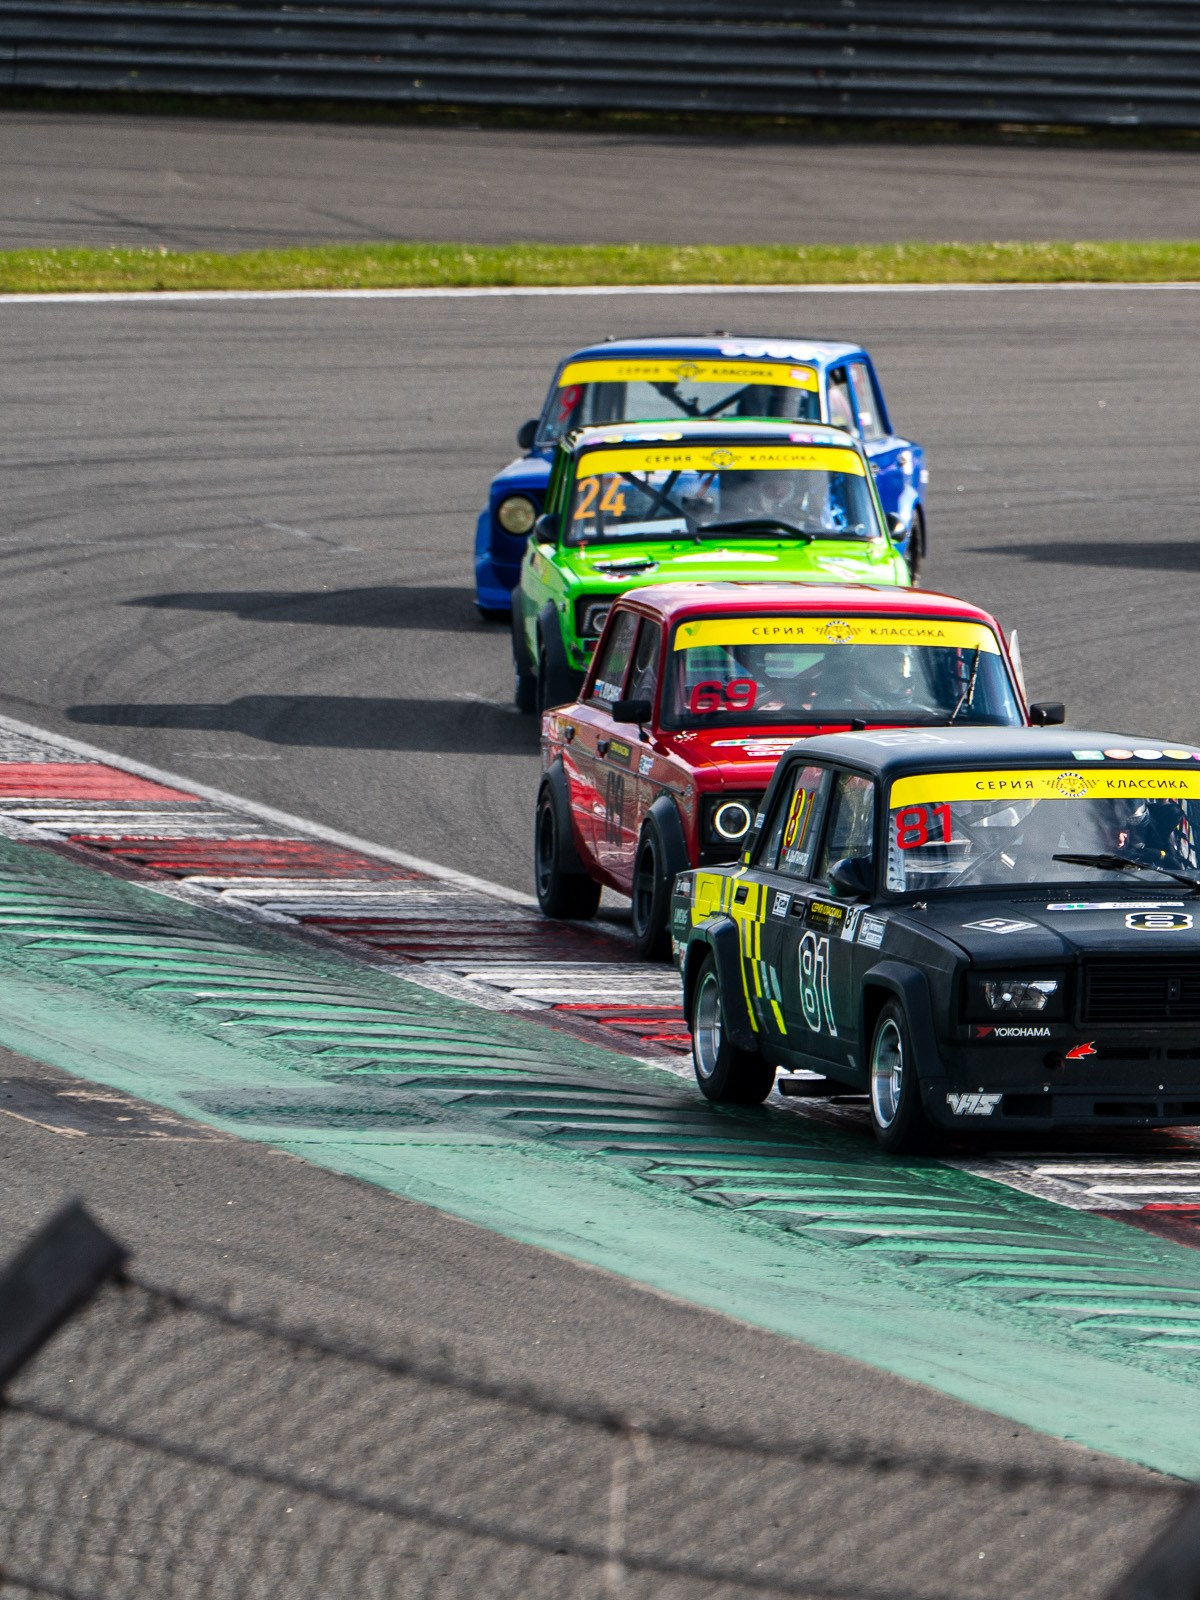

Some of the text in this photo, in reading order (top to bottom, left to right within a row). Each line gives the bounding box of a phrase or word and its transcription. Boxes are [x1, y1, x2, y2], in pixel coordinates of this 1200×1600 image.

[711, 368, 774, 378] КЛАССИКА
[645, 454, 816, 464] СЕРИЯ КЛАССИКА
[573, 476, 627, 521] 24
[752, 626, 946, 638] СЕРИЯ КЛАССИКА
[689, 678, 758, 715] 69
[975, 779, 1189, 791] СЕРИЯ КЛАССИКА
[783, 787, 816, 851] 81
[895, 804, 952, 849] 81
[845, 907, 861, 931] 81
[799, 930, 838, 1037] 81
[993, 1027, 1051, 1037] YOKOHAMA
